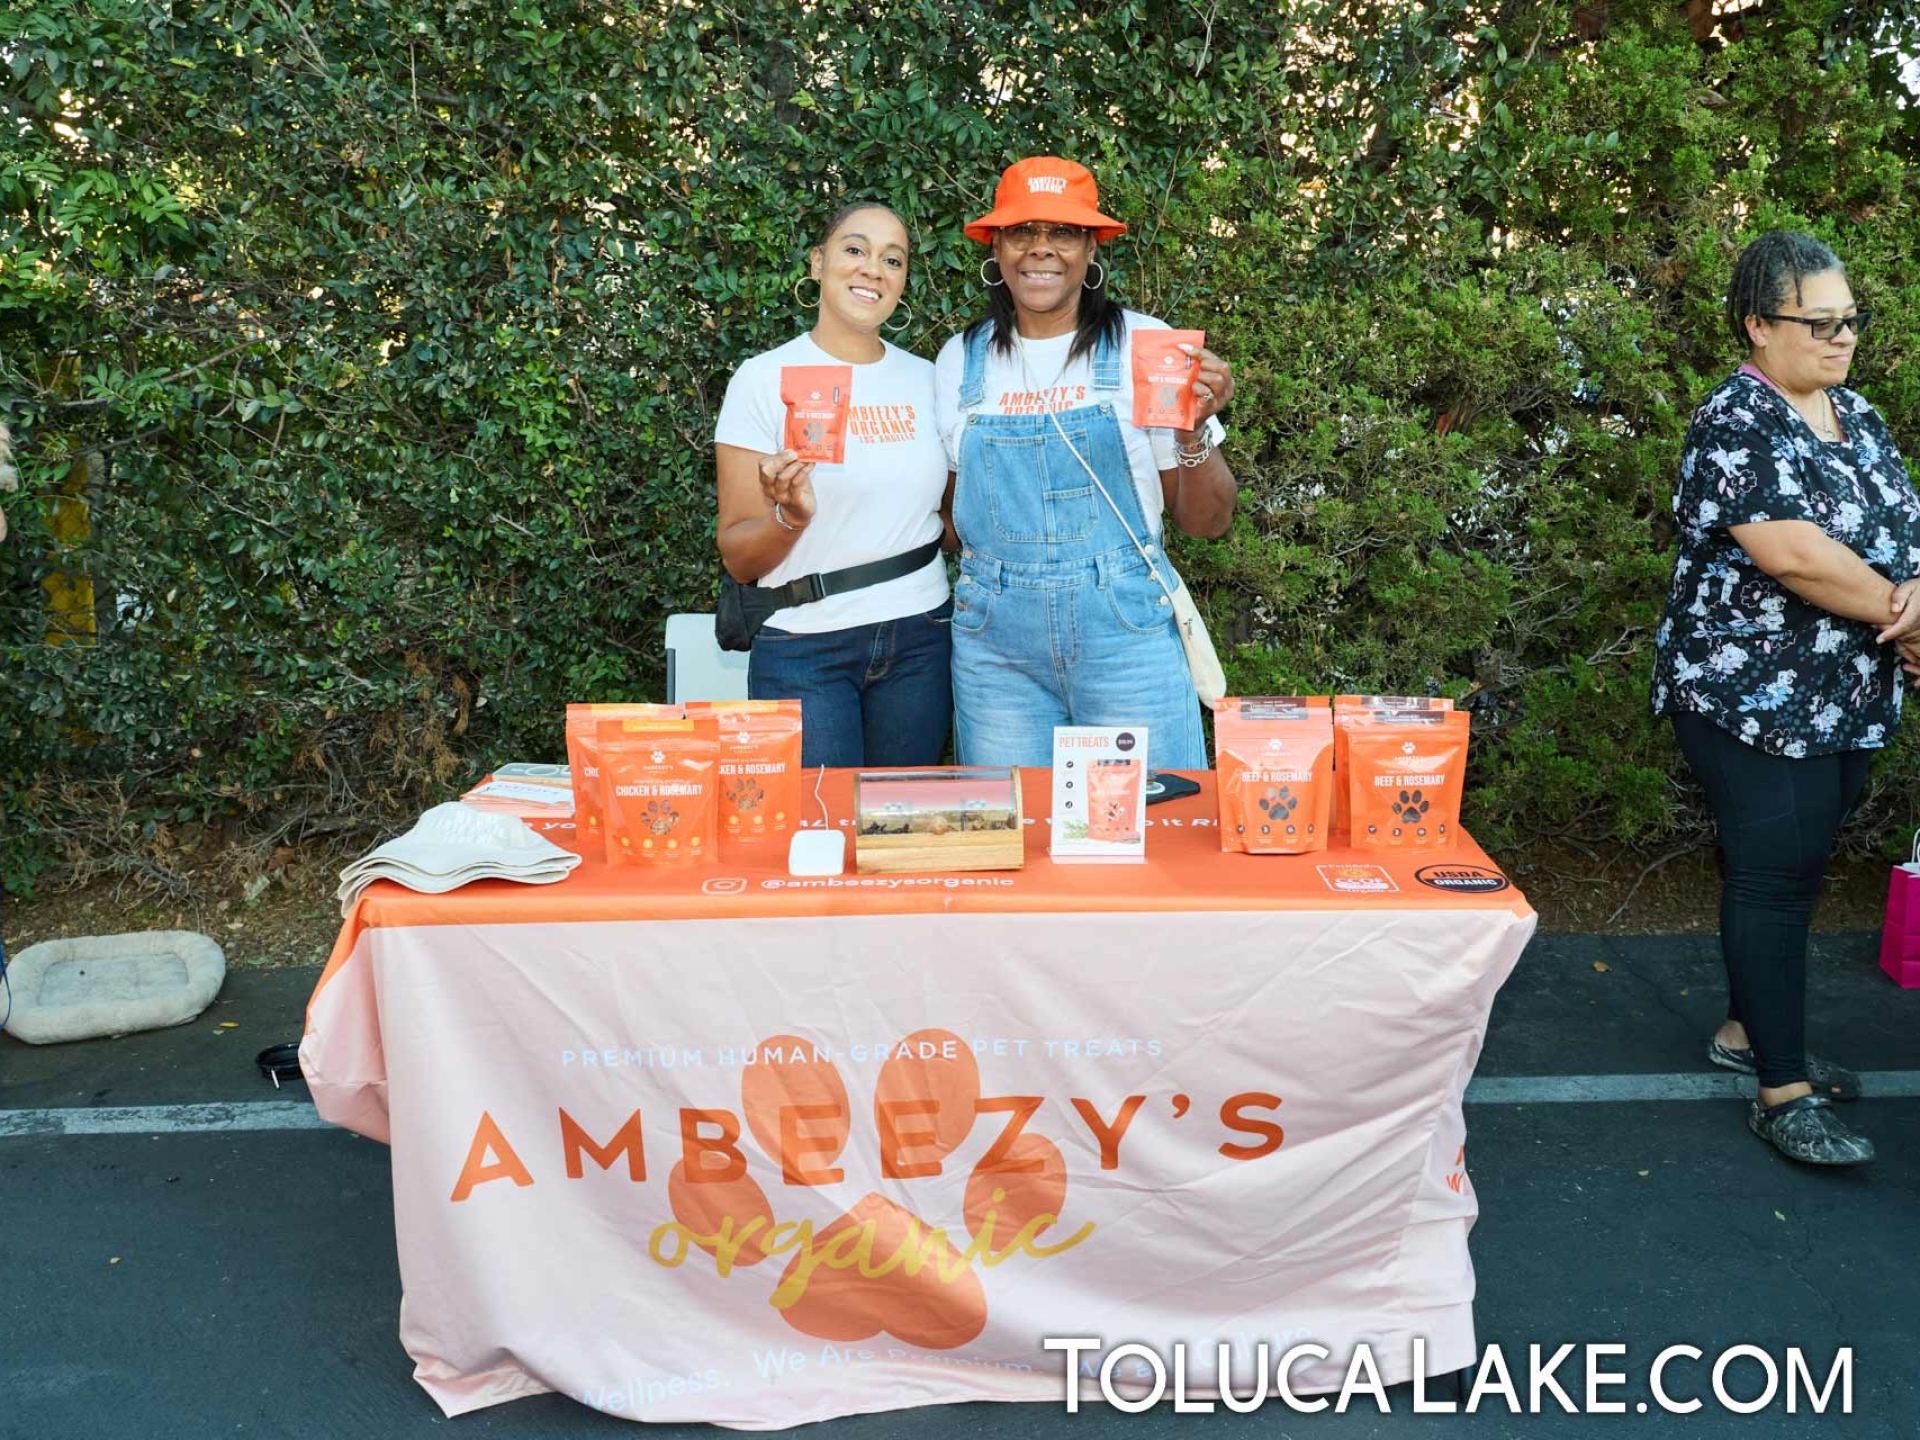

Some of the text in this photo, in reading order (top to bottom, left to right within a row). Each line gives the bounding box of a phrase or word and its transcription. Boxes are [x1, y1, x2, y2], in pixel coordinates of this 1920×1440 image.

[849, 405, 916, 421] MBEEZY'S
[1077, 737, 1110, 747] TREATS
[746, 763, 786, 775] ROSEMARY
[1242, 771, 1262, 783] BEEF
[1271, 771, 1313, 783] ROSEMARY
[1374, 774, 1445, 787] BEEF & ROSEMARY
[616, 784, 703, 797] CHICKEN & ROSEMARY
[761, 877, 1015, 889] @ambeezysorganic
[562, 1038, 1163, 1069] PREMIUM HUMAN-GRADE PET TREATS
[450, 1091, 1285, 1202] AMBEEZY'S
[648, 1187, 1096, 1309] organic
[752, 1348, 807, 1379] We
